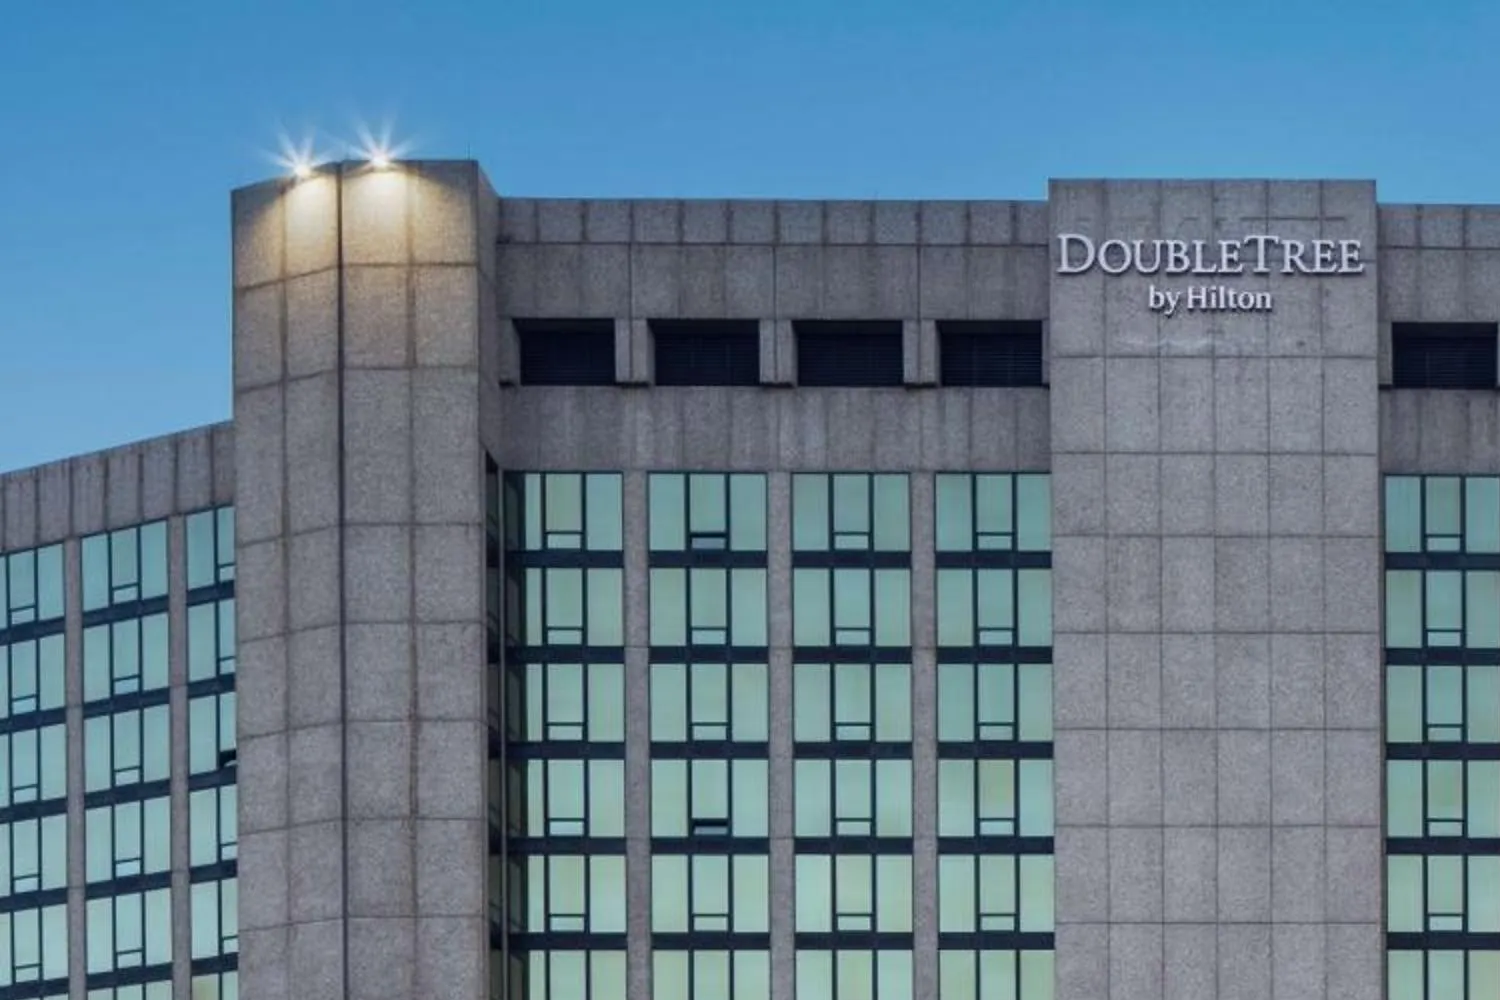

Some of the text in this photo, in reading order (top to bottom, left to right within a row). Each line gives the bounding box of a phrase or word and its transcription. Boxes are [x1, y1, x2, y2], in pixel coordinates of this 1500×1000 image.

[1057, 233, 1364, 273] DOUBLETREE
[1149, 286, 1272, 314] by Hilton
